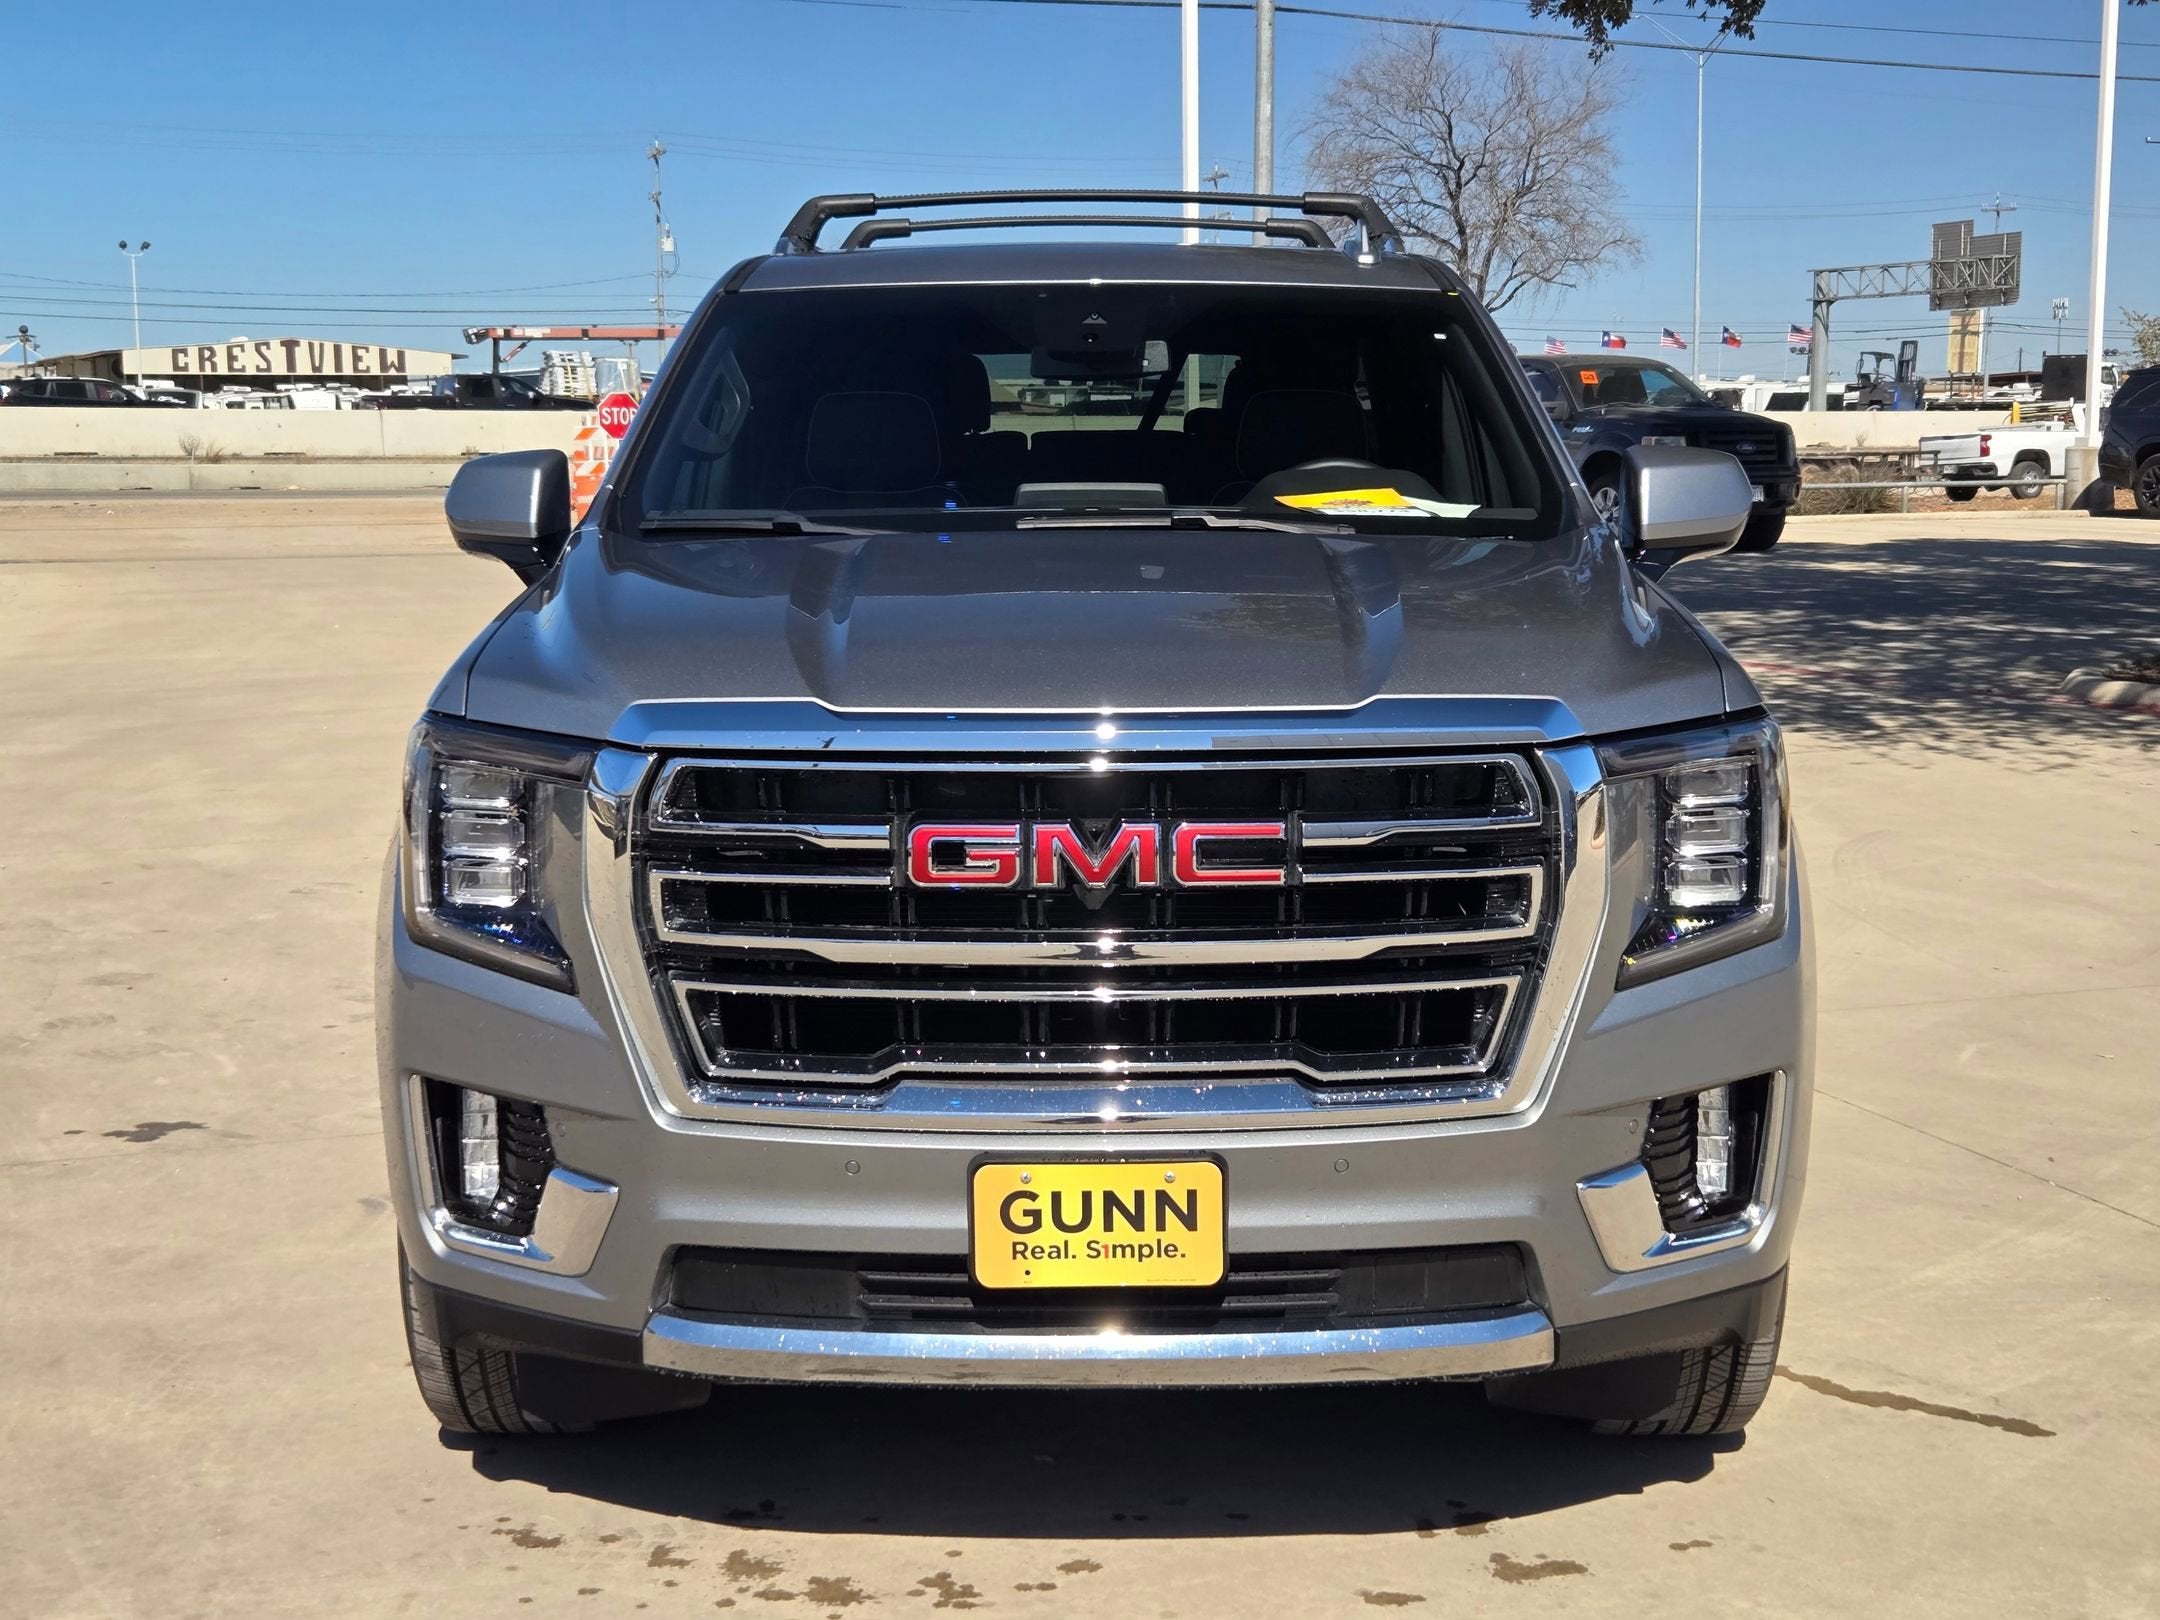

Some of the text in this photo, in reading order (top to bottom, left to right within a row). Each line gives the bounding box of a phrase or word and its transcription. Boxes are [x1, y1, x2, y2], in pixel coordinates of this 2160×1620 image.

[171, 339, 406, 373] CRESTVIEW
[907, 820, 1287, 888] GMC
[1000, 1189, 1198, 1234] GUNN
[1012, 1240, 1077, 1260] Real.
